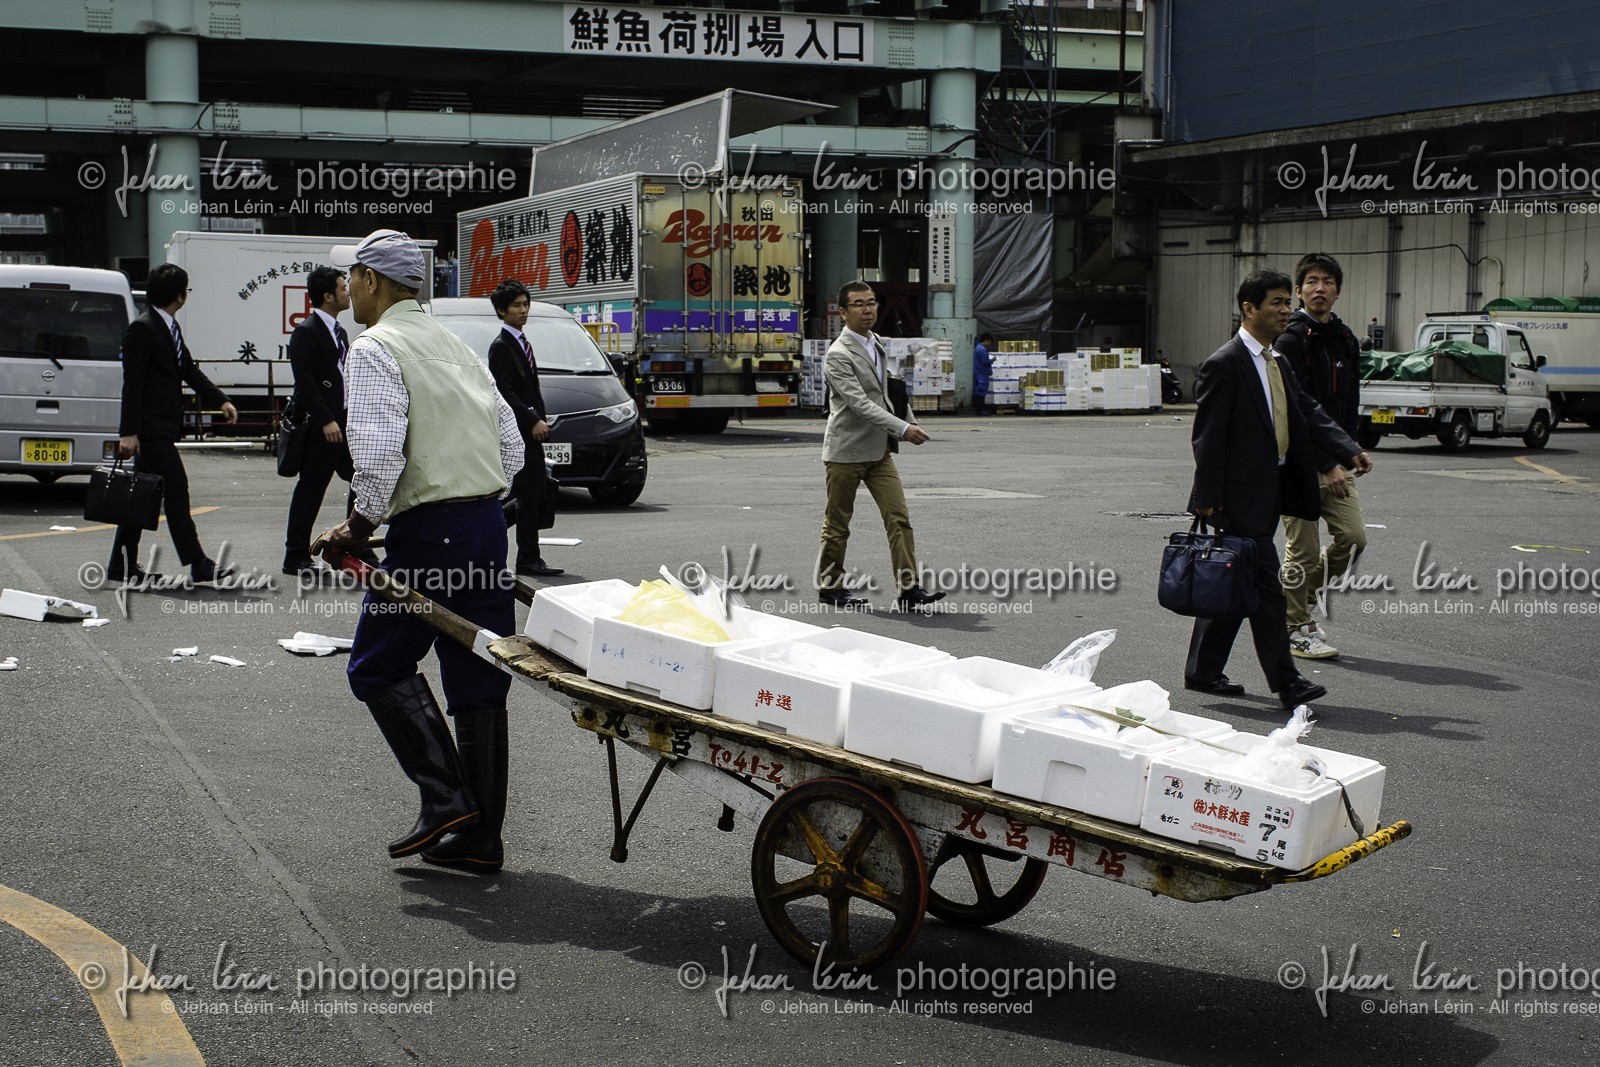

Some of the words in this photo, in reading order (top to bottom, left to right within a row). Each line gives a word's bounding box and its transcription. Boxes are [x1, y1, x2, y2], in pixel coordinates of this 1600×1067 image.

[569, 7, 864, 62] 鮮魚荷捌場入口
[519, 209, 550, 238] AKITA
[733, 264, 791, 297] 築地
[744, 308, 791, 322] 直送便
[658, 381, 683, 391] 83-06
[34, 449, 67, 461] 80-08
[547, 452, 570, 463] 9-99
[757, 688, 792, 711] 特選
[1164, 787, 1184, 800] ボイル
[1259, 822, 1277, 842] 7
[1256, 849, 1269, 862] 5
[1271, 849, 1285, 861] kg
